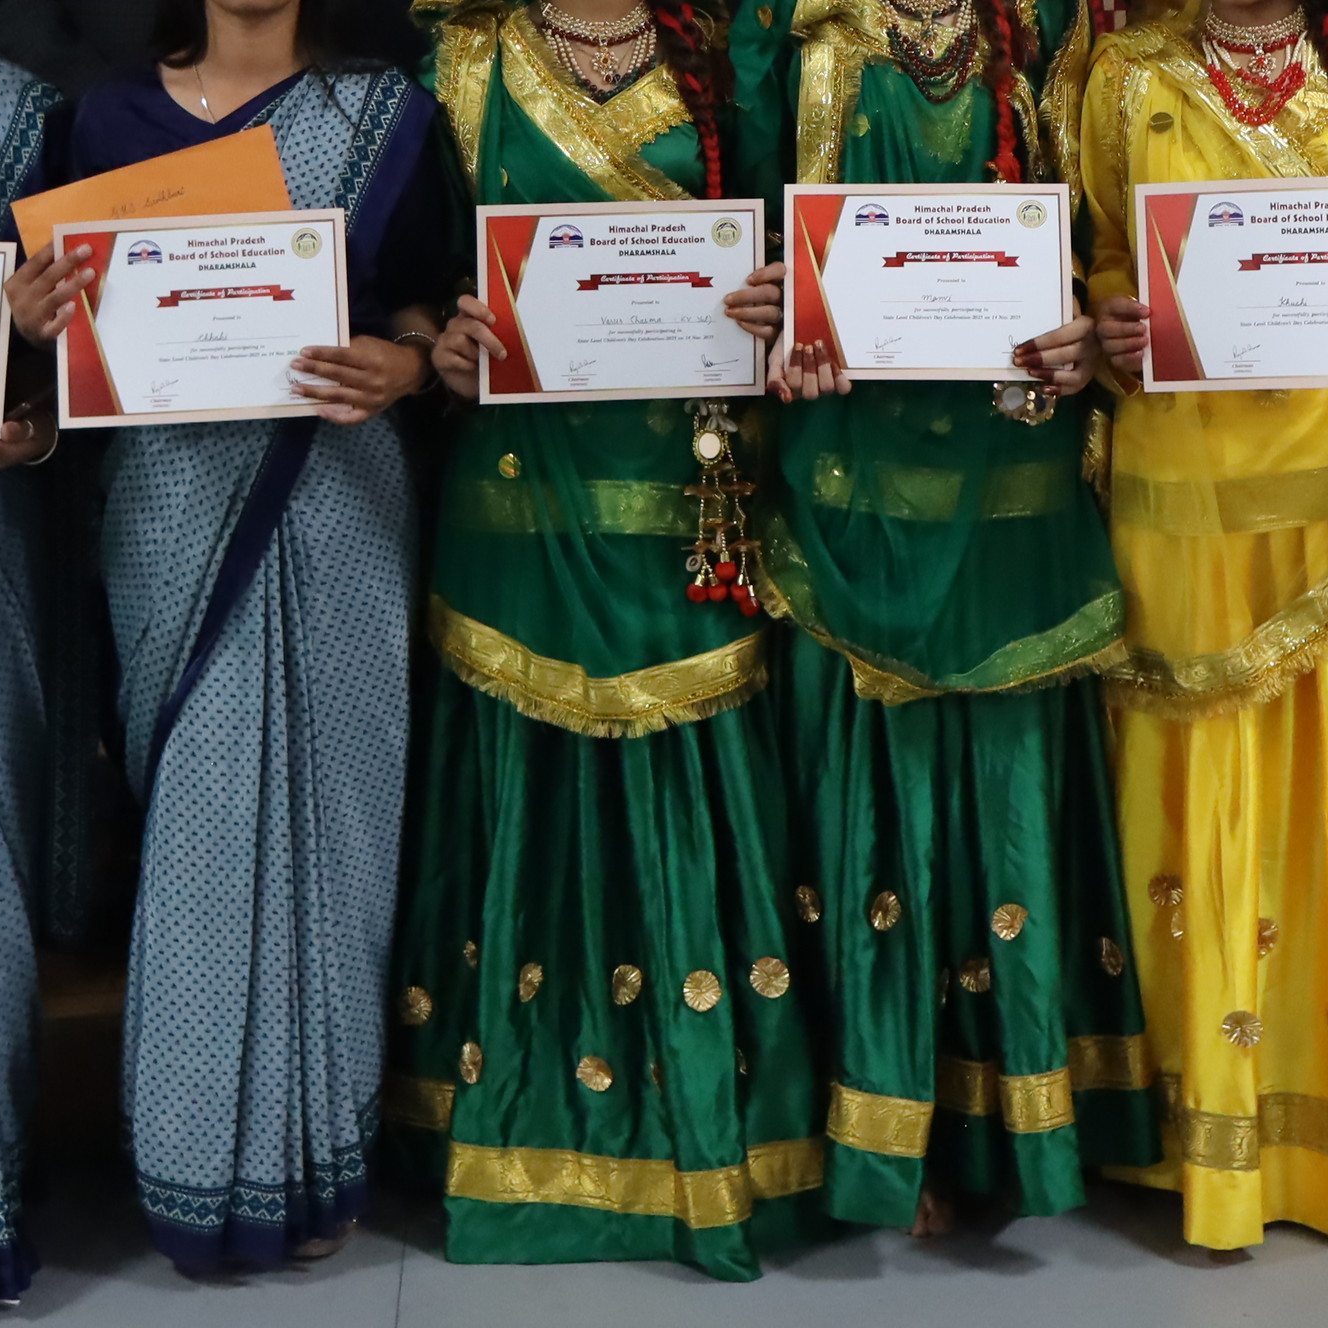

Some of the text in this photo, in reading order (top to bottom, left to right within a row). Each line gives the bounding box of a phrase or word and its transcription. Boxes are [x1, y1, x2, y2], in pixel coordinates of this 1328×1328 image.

[1270, 201, 1311, 210] Himachal
[896, 216, 1010, 224] Board of School Education
[1250, 214, 1277, 223] Board
[1281, 214, 1290, 223] of
[1293, 213, 1322, 222] School
[608, 223, 686, 233] Himachal Pradesh
[187, 235, 265, 247] Himachal Pradesh
[590, 235, 705, 245] Board of School Education
[168, 247, 285, 261] Board of School Education
[619, 248, 676, 256] DHARAMSHALA
[198, 261, 256, 271] DHARAMSHALA
